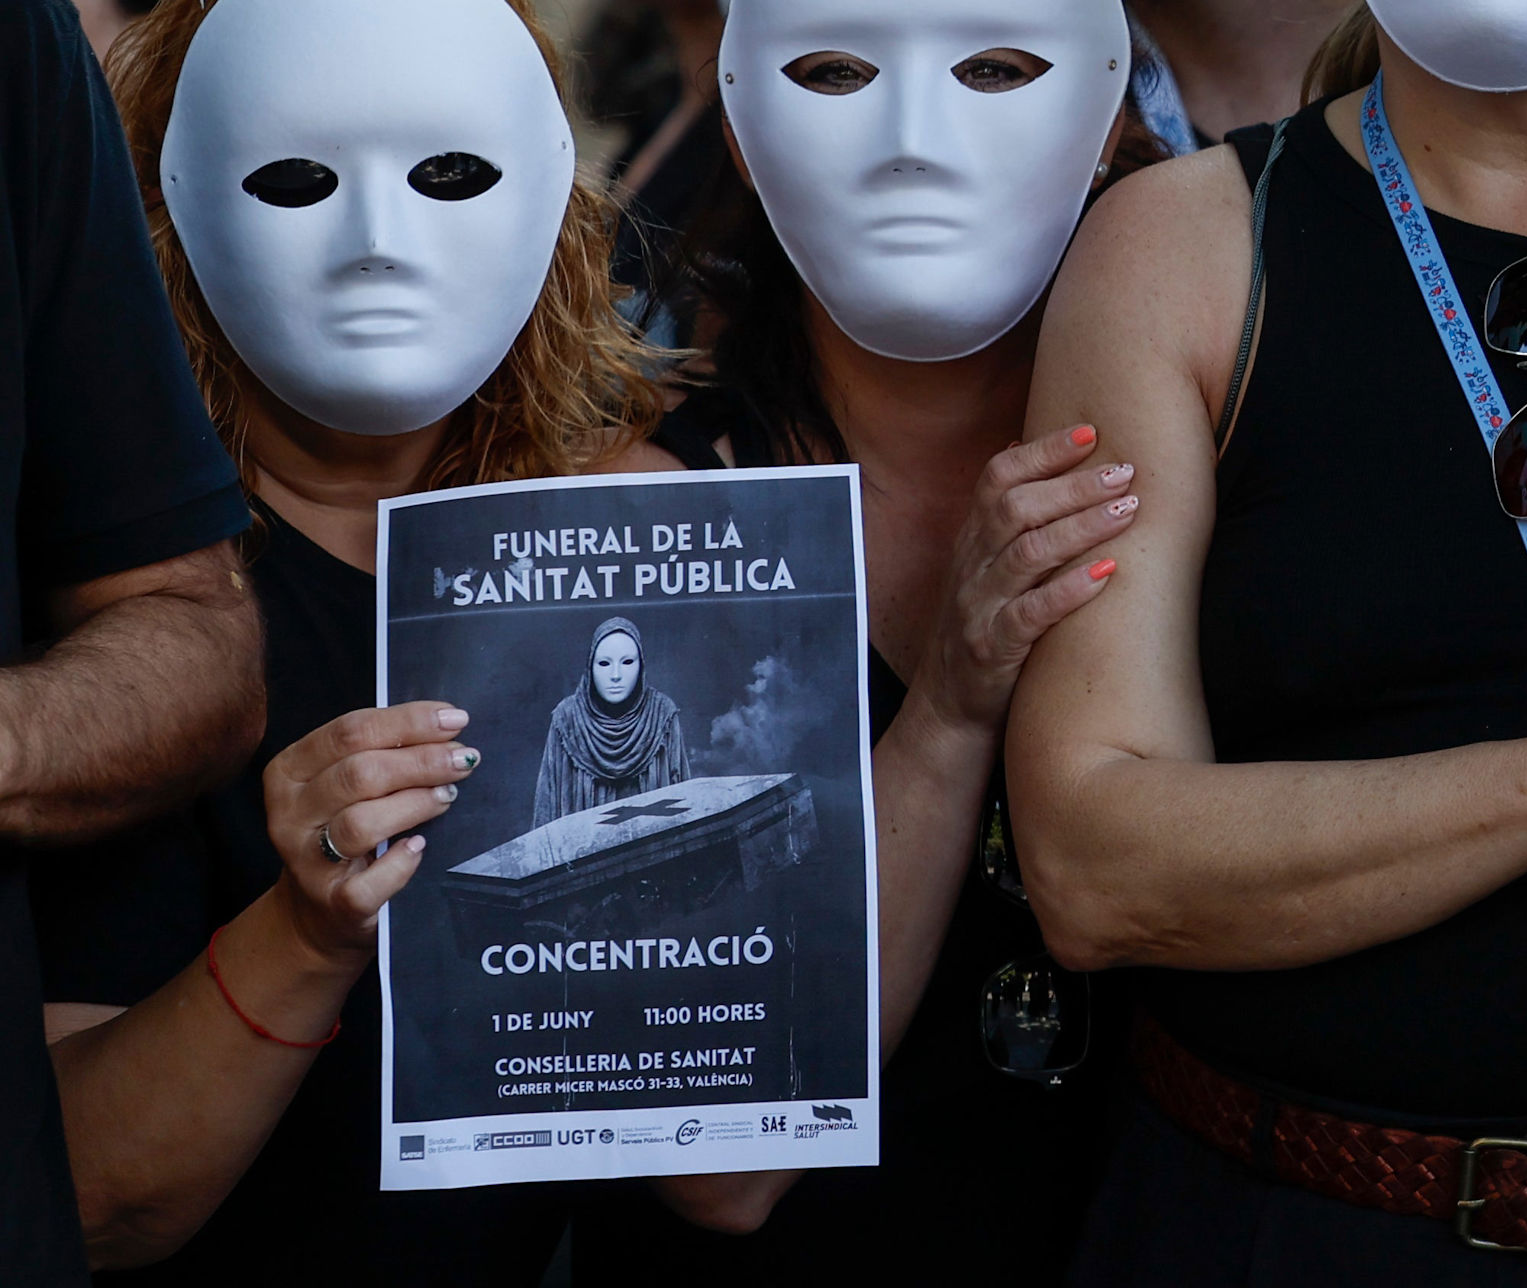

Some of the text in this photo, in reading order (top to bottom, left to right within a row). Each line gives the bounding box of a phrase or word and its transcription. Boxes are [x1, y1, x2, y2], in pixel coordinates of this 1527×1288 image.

[494, 520, 744, 561] FUNERAL DE LA
[453, 556, 796, 607] SANITAT PÚBLICA
[481, 927, 774, 976] CONCENTRACIÓ
[492, 1010, 594, 1033] 1 DE JUNY
[643, 1003, 766, 1026] 11:00 HORES
[495, 1048, 756, 1076] CONSELLERIA DE SANITAT
[498, 1081, 551, 1099] (CARRER
[555, 1080, 594, 1093] MICER
[597, 1075, 645, 1091] MASCÓ
[648, 1076, 683, 1090] 31-33,
[681, 1126, 704, 1137] CSIF
[761, 1116, 787, 1133] SAE
[795, 1122, 858, 1132] INTERSINDICAL
[493, 1134, 534, 1147] CCOO
[557, 1129, 596, 1146] UGT
